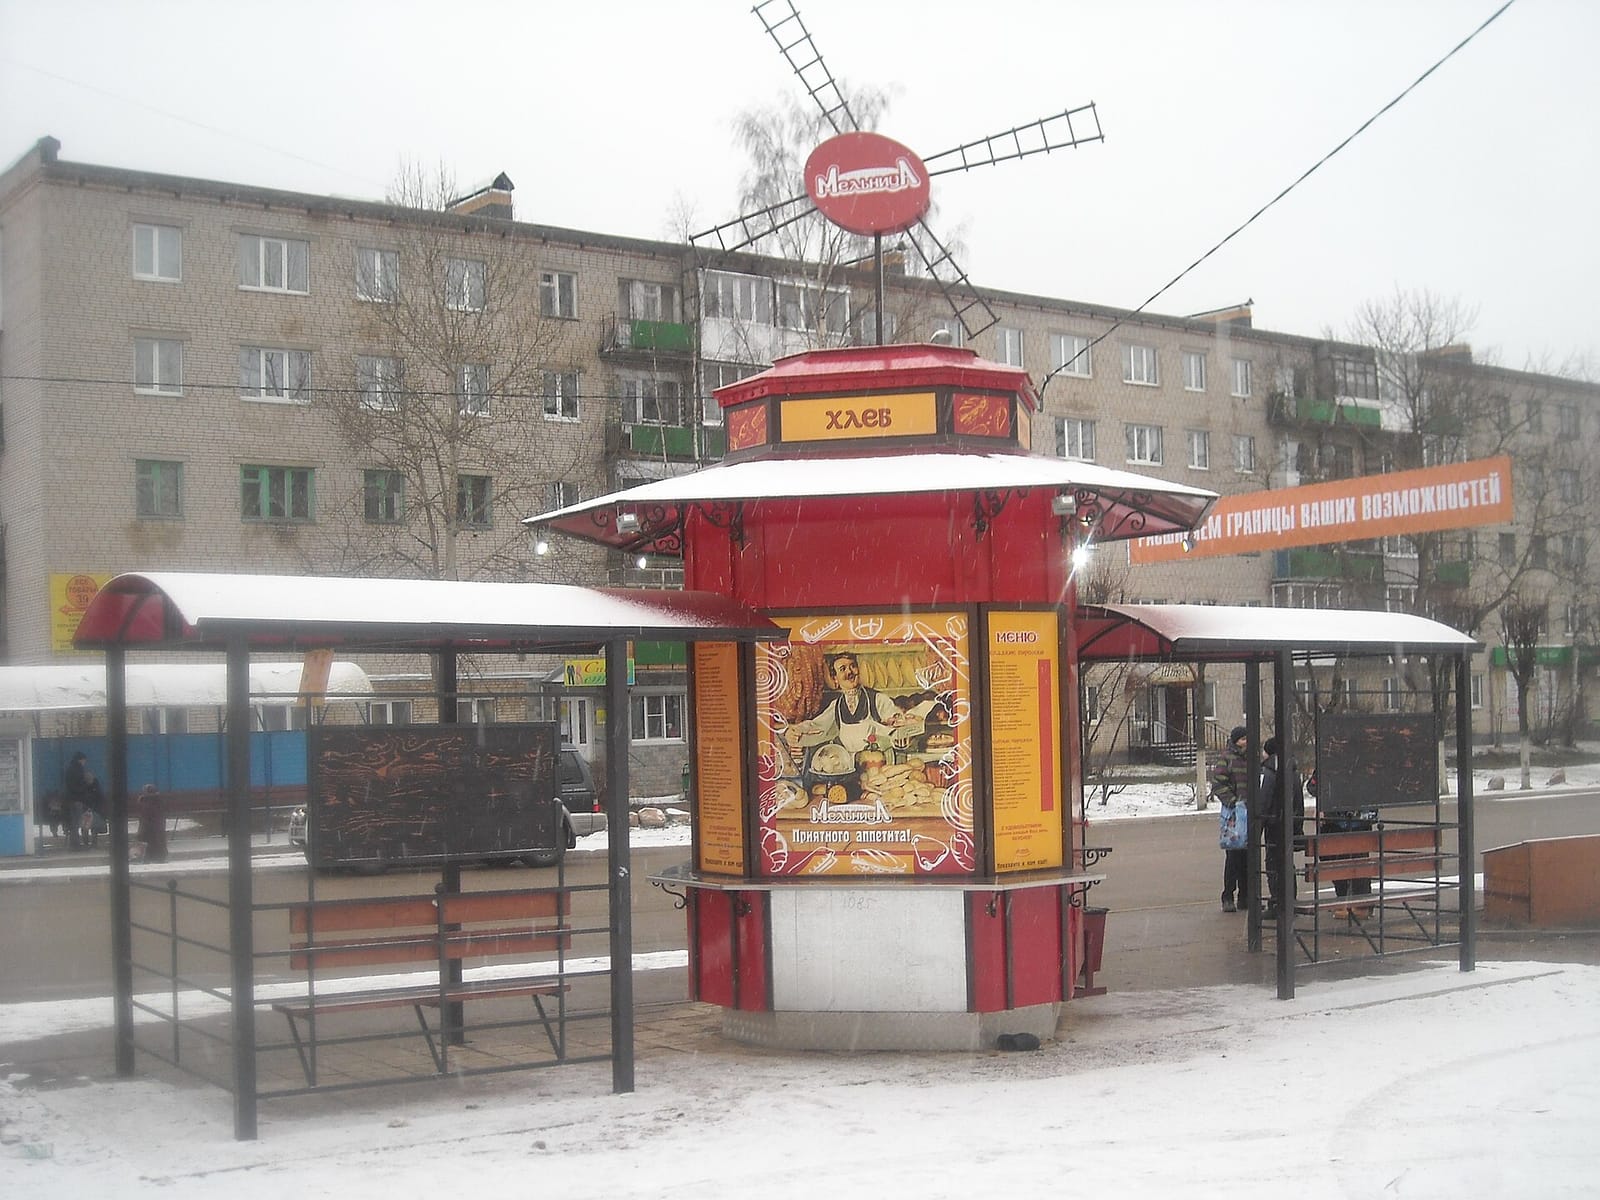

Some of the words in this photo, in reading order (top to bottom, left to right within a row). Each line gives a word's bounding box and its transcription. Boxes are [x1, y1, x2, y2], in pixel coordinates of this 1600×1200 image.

[1227, 505, 1295, 536] ГРАНИЦЫ
[1301, 497, 1356, 528] ВАШИХ
[1362, 472, 1500, 521] ВОЗМОЖНОСТЕЙ
[996, 632, 1037, 643] МЕНЮ
[792, 829, 850, 843] Приятного
[856, 829, 911, 842] аппетита!
